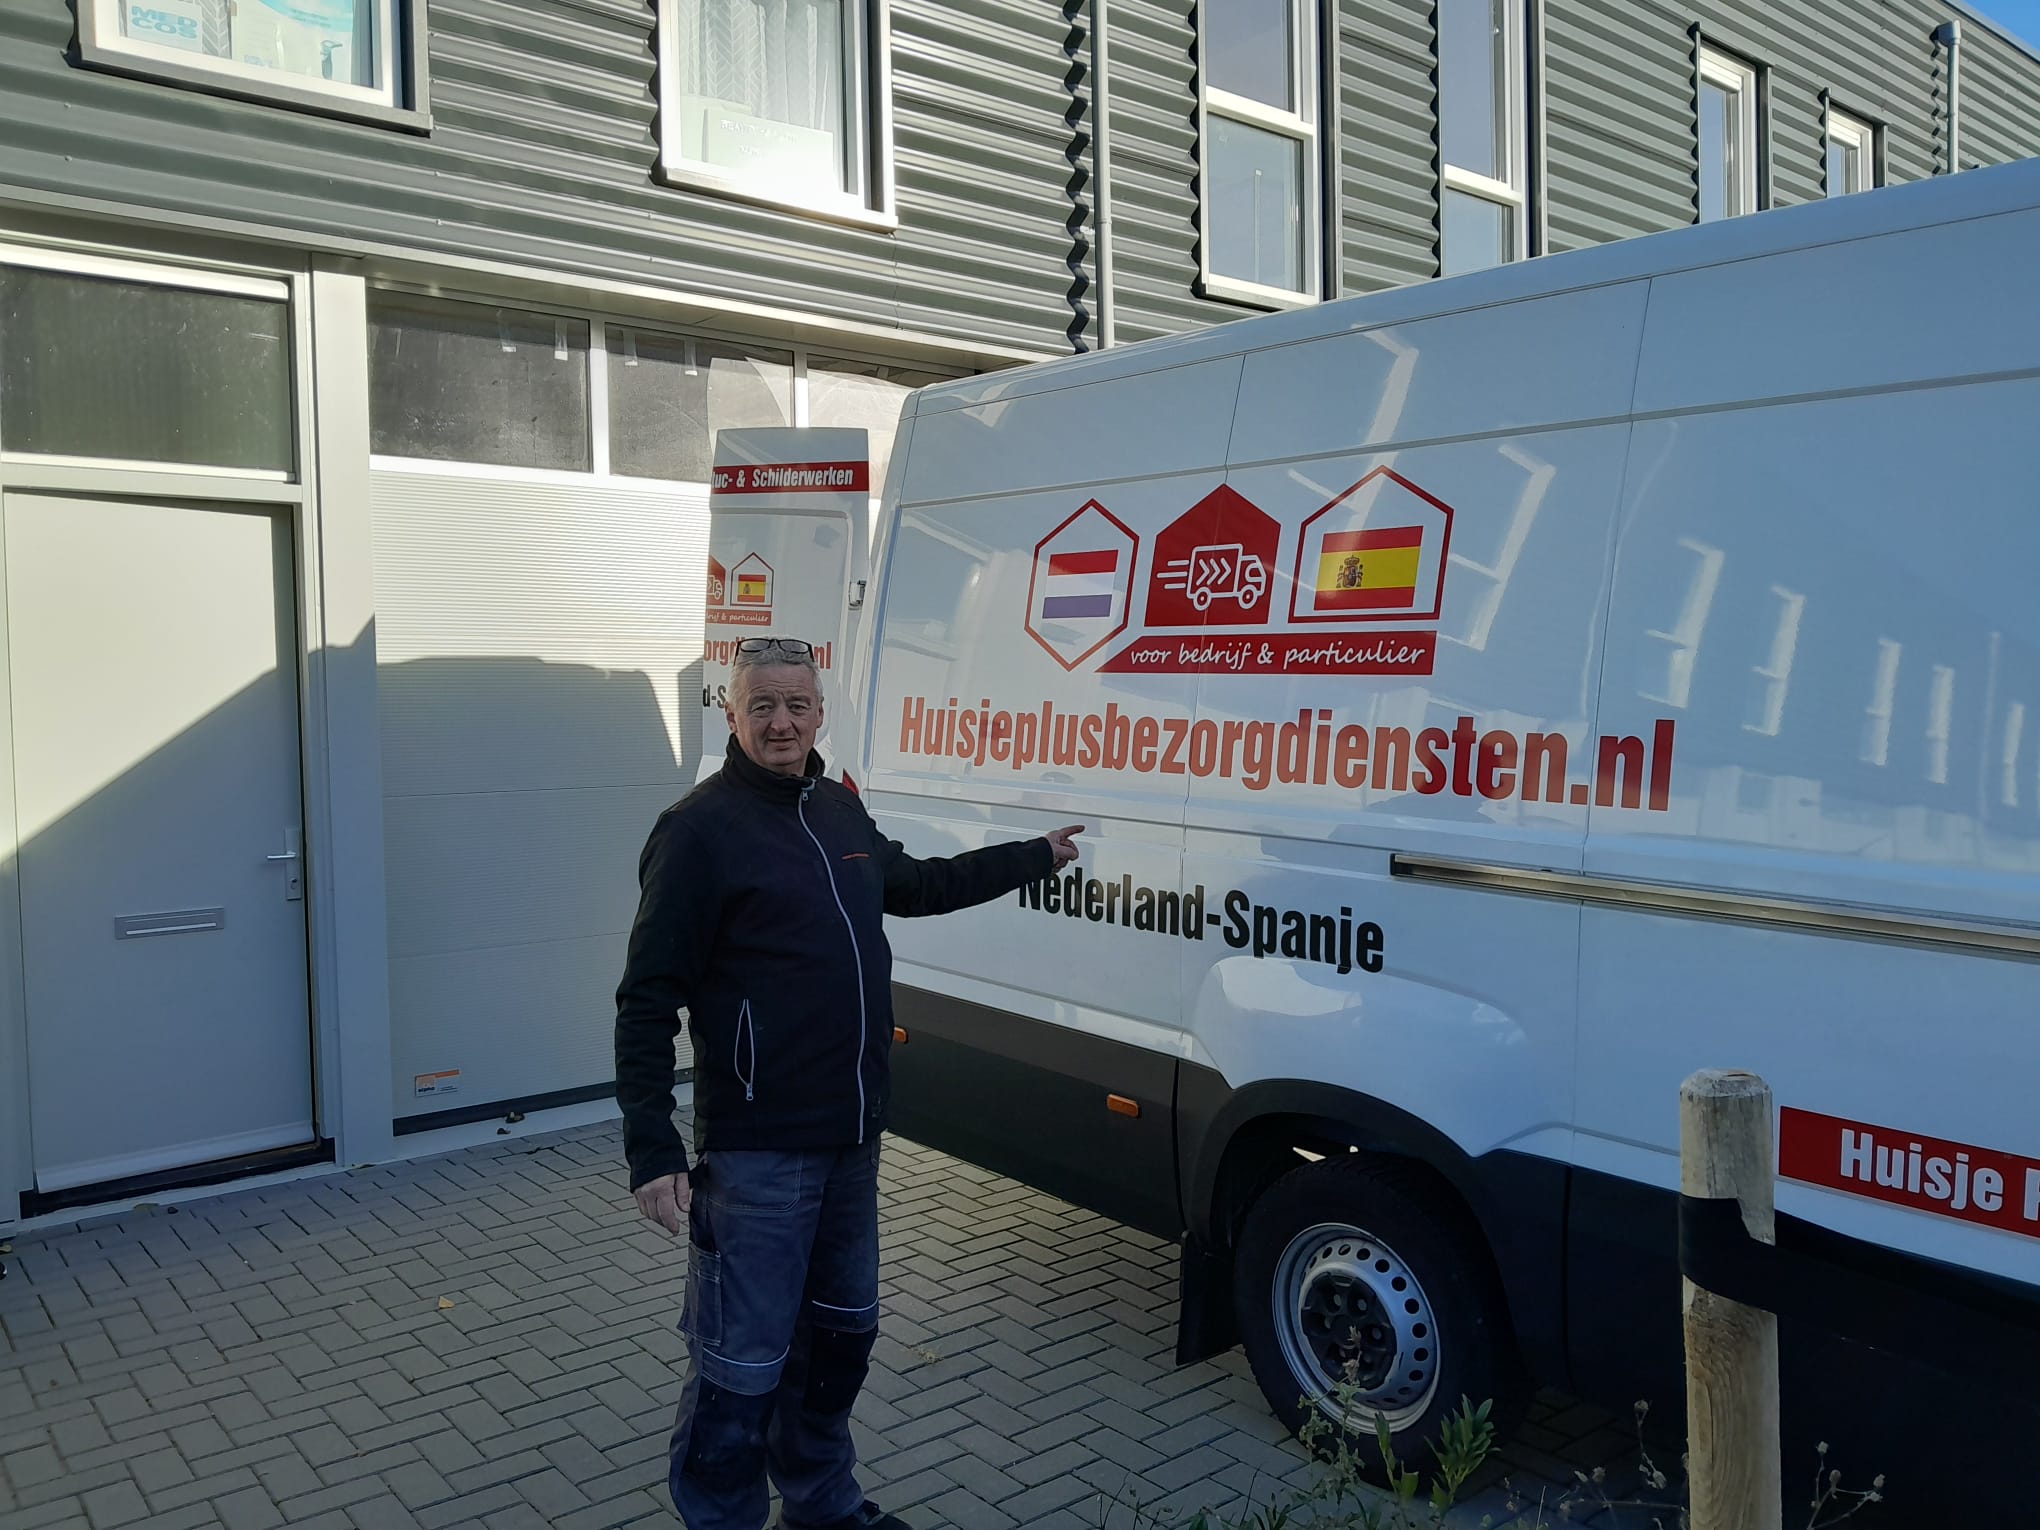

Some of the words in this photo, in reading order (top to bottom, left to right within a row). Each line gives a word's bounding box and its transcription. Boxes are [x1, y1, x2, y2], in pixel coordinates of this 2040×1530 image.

[736, 470, 745, 488] &
[752, 466, 853, 488] Schilderwerken
[729, 614, 769, 623] particulier
[1130, 648, 1172, 665] voor
[1178, 640, 1252, 669] bedrijf
[1258, 643, 1274, 665] &
[1283, 640, 1425, 669] particulier
[900, 696, 1675, 811] Huisjeplusbezorgdiensten.nl
[1019, 867, 1384, 974] Nederland-Spanje
[1841, 1128, 2004, 1212] Huisje
